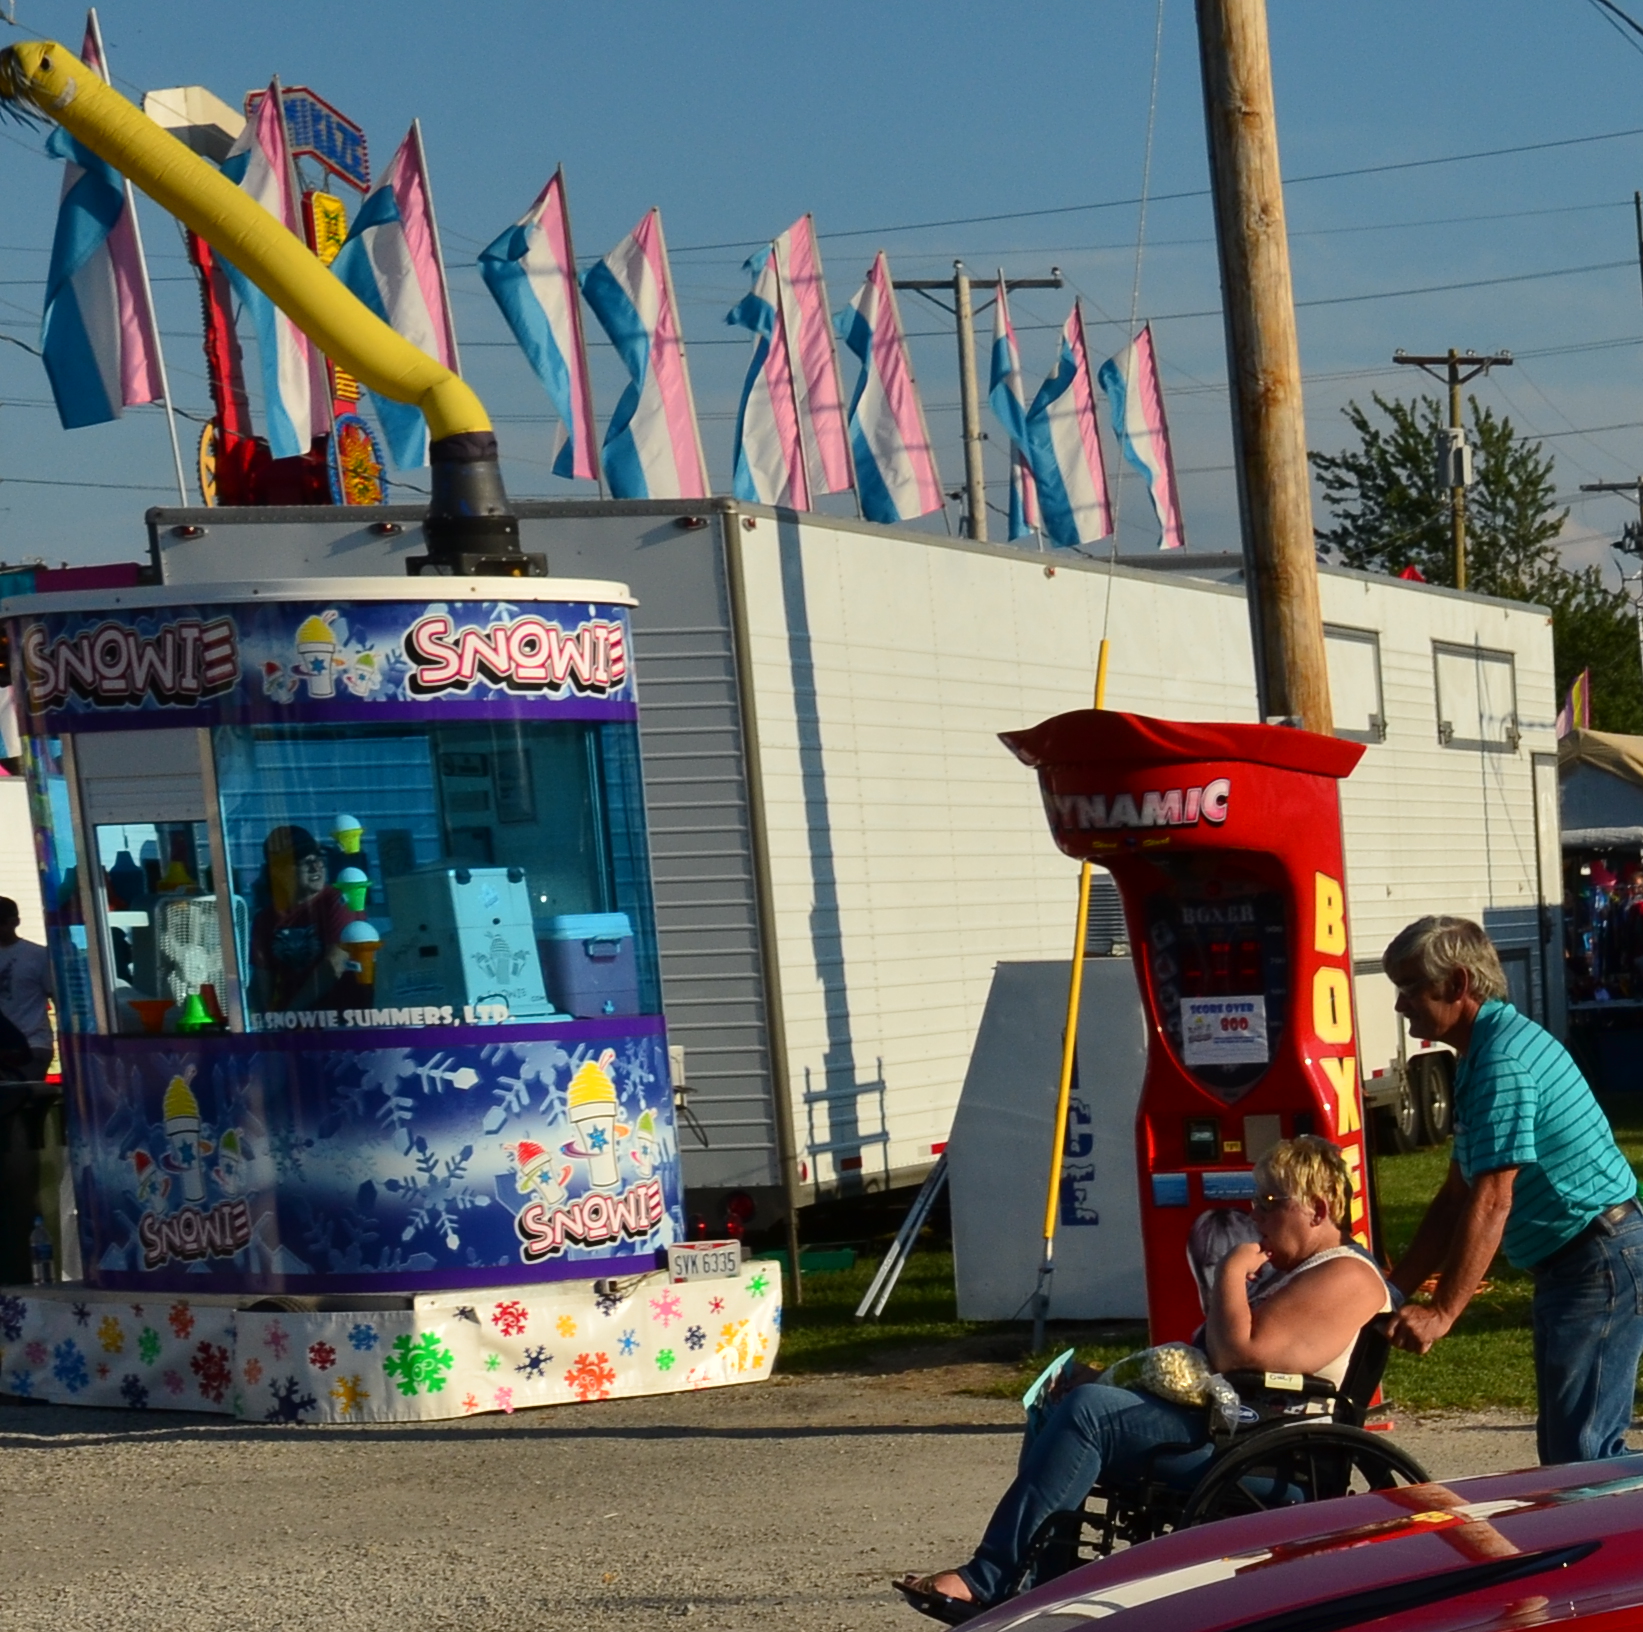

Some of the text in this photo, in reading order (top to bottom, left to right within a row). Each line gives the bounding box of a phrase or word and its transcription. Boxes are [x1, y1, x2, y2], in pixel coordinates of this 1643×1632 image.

[26, 616, 240, 710] SNOWIE
[408, 614, 627, 694] SNOWIE
[1182, 904, 1255, 924] BOXER
[264, 1004, 516, 1029] SNOWIE SUMMERS, LTD.
[139, 1203, 251, 1268] SNOWIE
[522, 1179, 661, 1260] SNOWIE
[674, 1251, 736, 1275] SVK 6335
